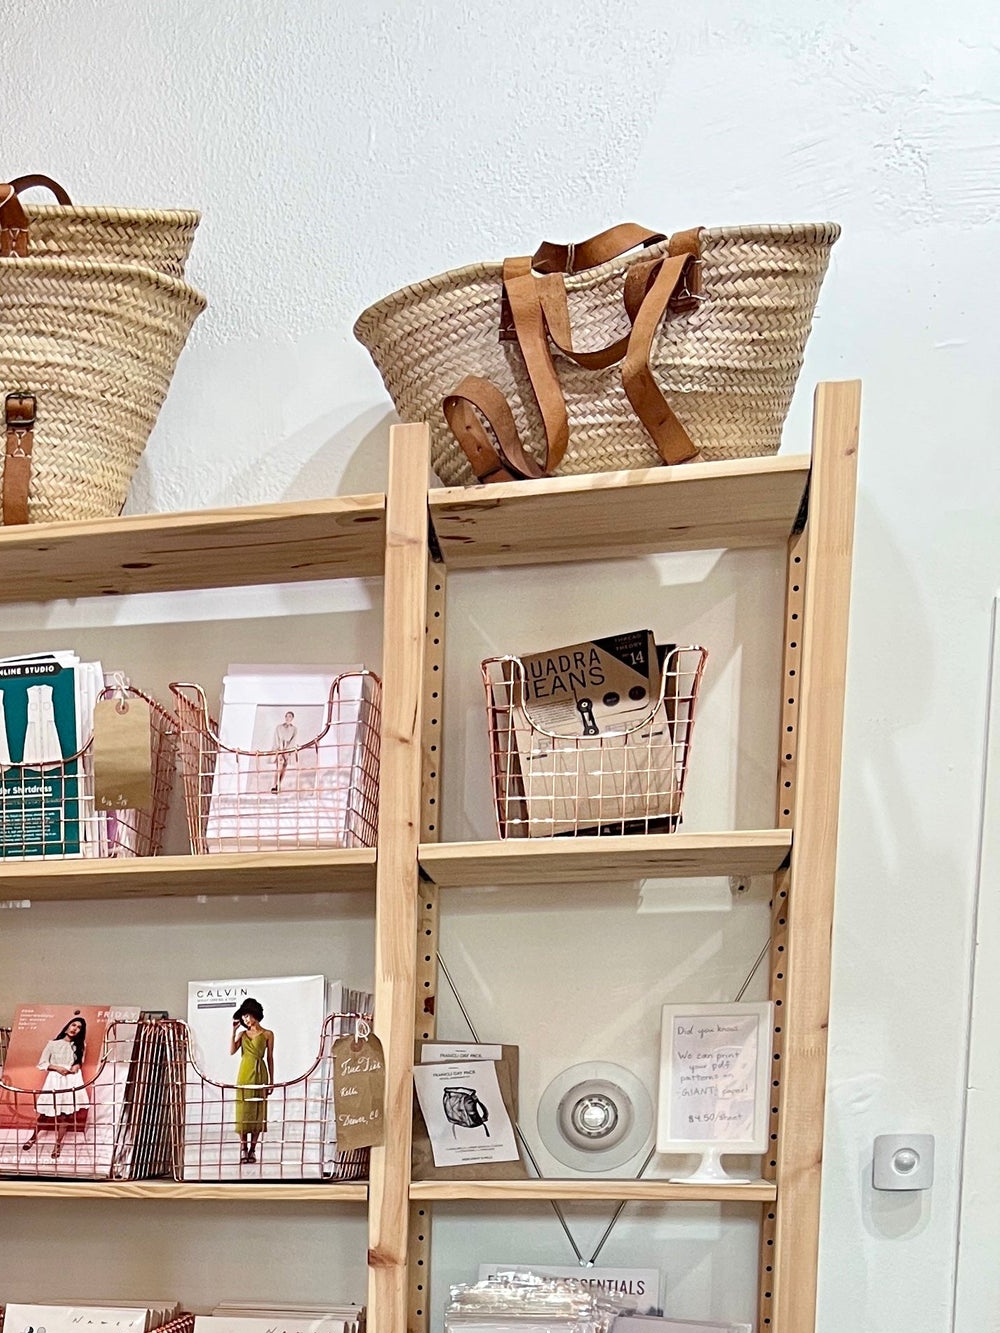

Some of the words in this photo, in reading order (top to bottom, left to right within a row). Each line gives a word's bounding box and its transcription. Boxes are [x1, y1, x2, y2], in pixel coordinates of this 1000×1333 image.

[629, 651, 645, 665] 14
[24, 665, 55, 675] STUDIO
[517, 648, 601, 681] QUADRA
[525, 667, 605, 701] JEANS
[12, 784, 53, 795] Shrtdress
[197, 988, 248, 998] CALVIN
[677, 1026, 694, 1035] Did
[697, 1028, 714, 1039] you
[677, 1051, 692, 1060] We
[716, 1052, 740, 1062] print
[711, 1061, 731, 1072] pdf
[680, 1074, 719, 1084] patterns
[681, 1086, 714, 1097] GIANT
